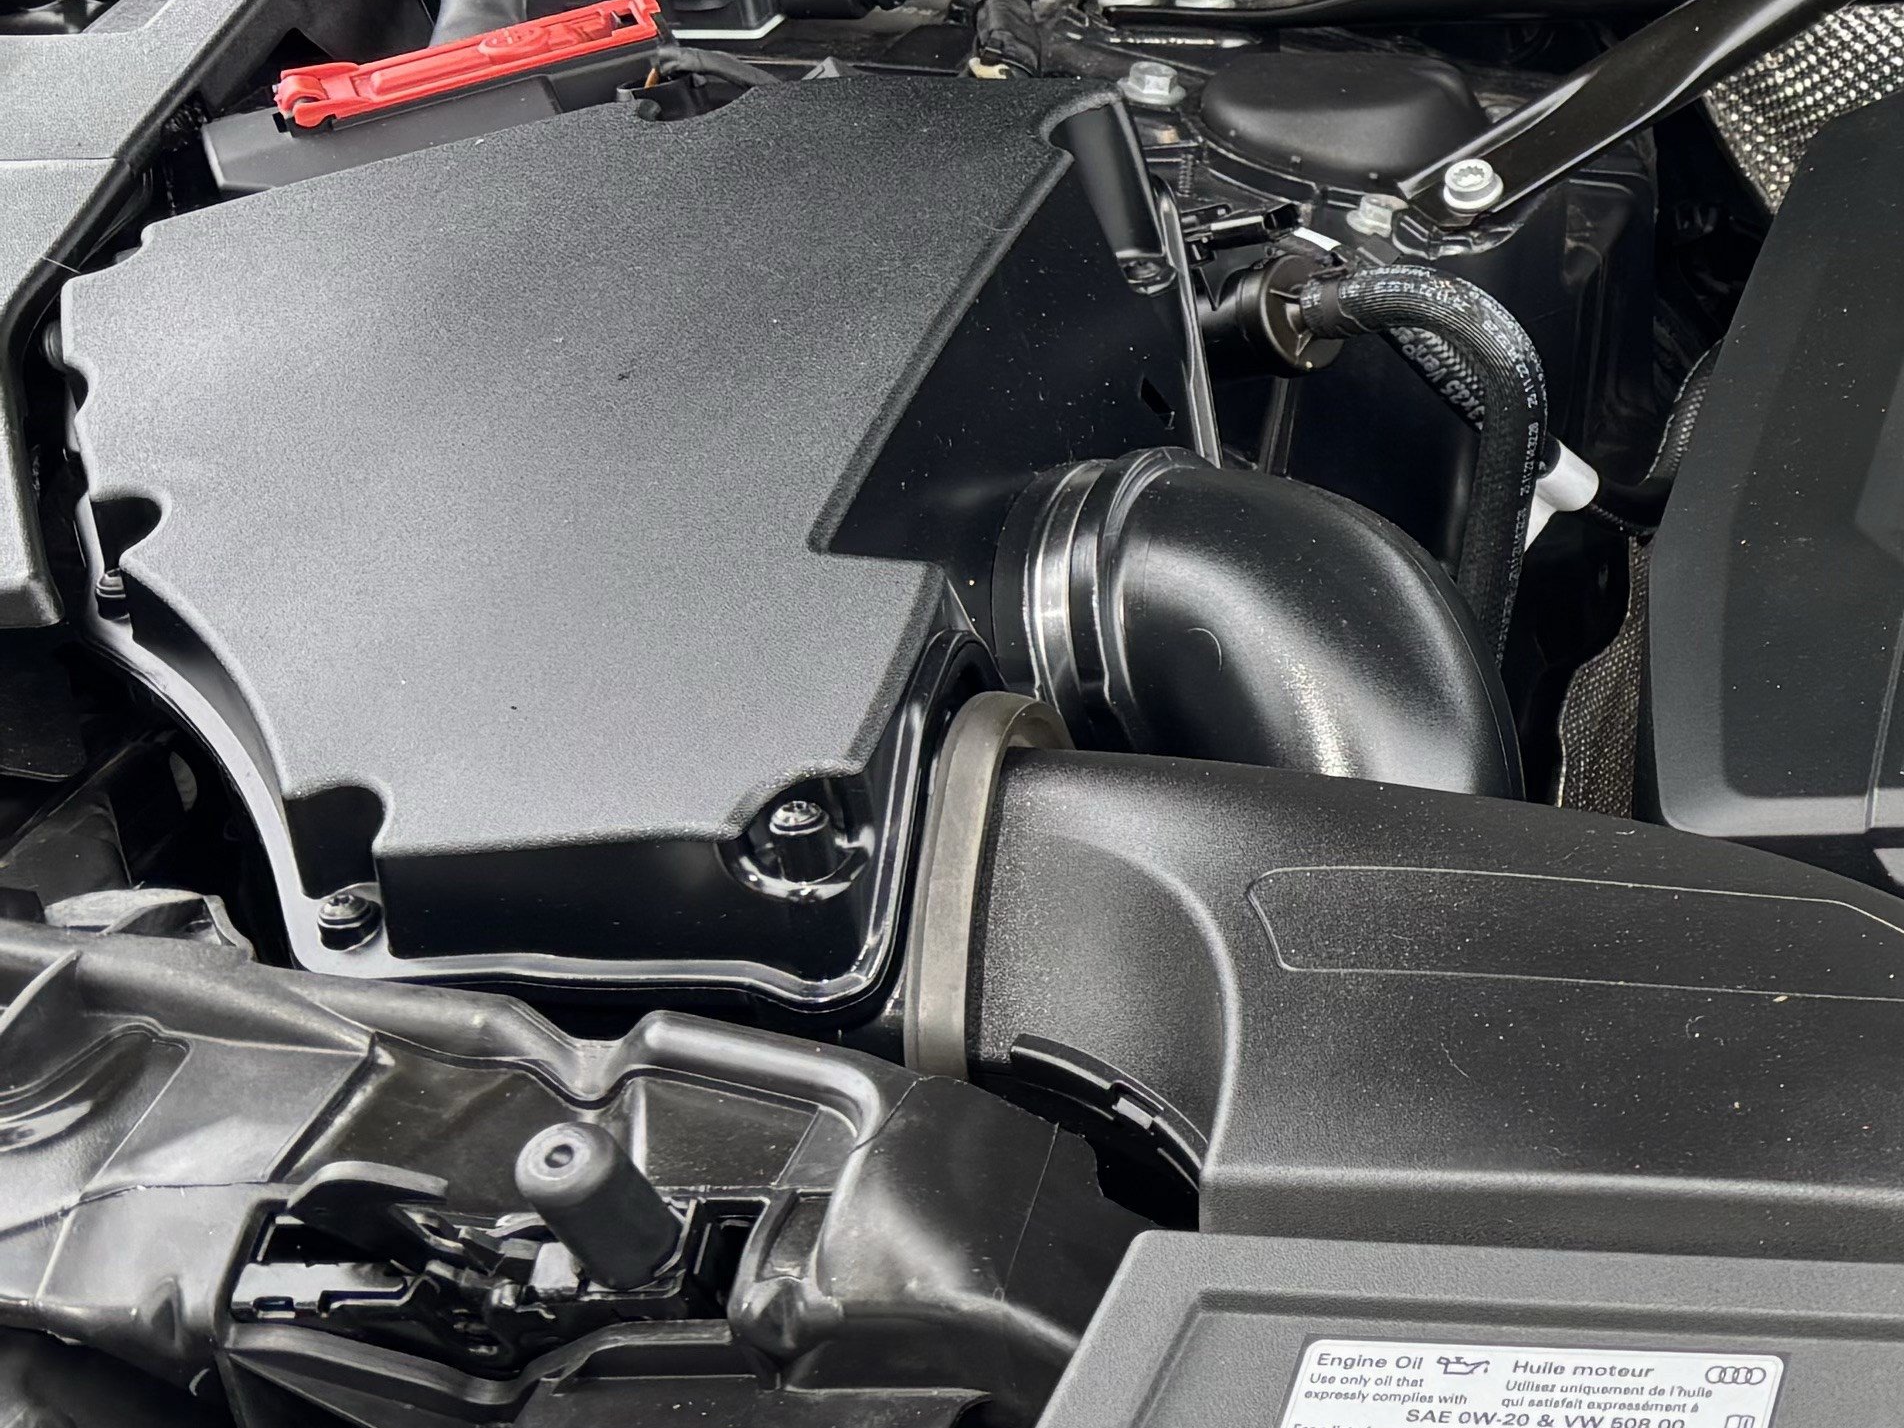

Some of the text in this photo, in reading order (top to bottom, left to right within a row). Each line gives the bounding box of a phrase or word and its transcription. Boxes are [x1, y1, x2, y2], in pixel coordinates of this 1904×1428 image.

[1317, 1353, 1423, 1370] Engine Oil
[1512, 1360, 1655, 1378] Huile moteur
[1309, 1373, 1424, 1388] Use only oil that
[1304, 1390, 1468, 1405] expressly complies with
[1505, 1380, 1713, 1399] Utilisez uniquement de l'huile
[1501, 1397, 1524, 1410] qui
[1528, 1397, 1583, 1410] satisfait
[1587, 1399, 1687, 1414] expressément
[1406, 1409, 1452, 1423] SAE
[1458, 1410, 1530, 1428] 0W-20
[1537, 1415, 1554, 1428] &
[1564, 1415, 1604, 1428] VW
